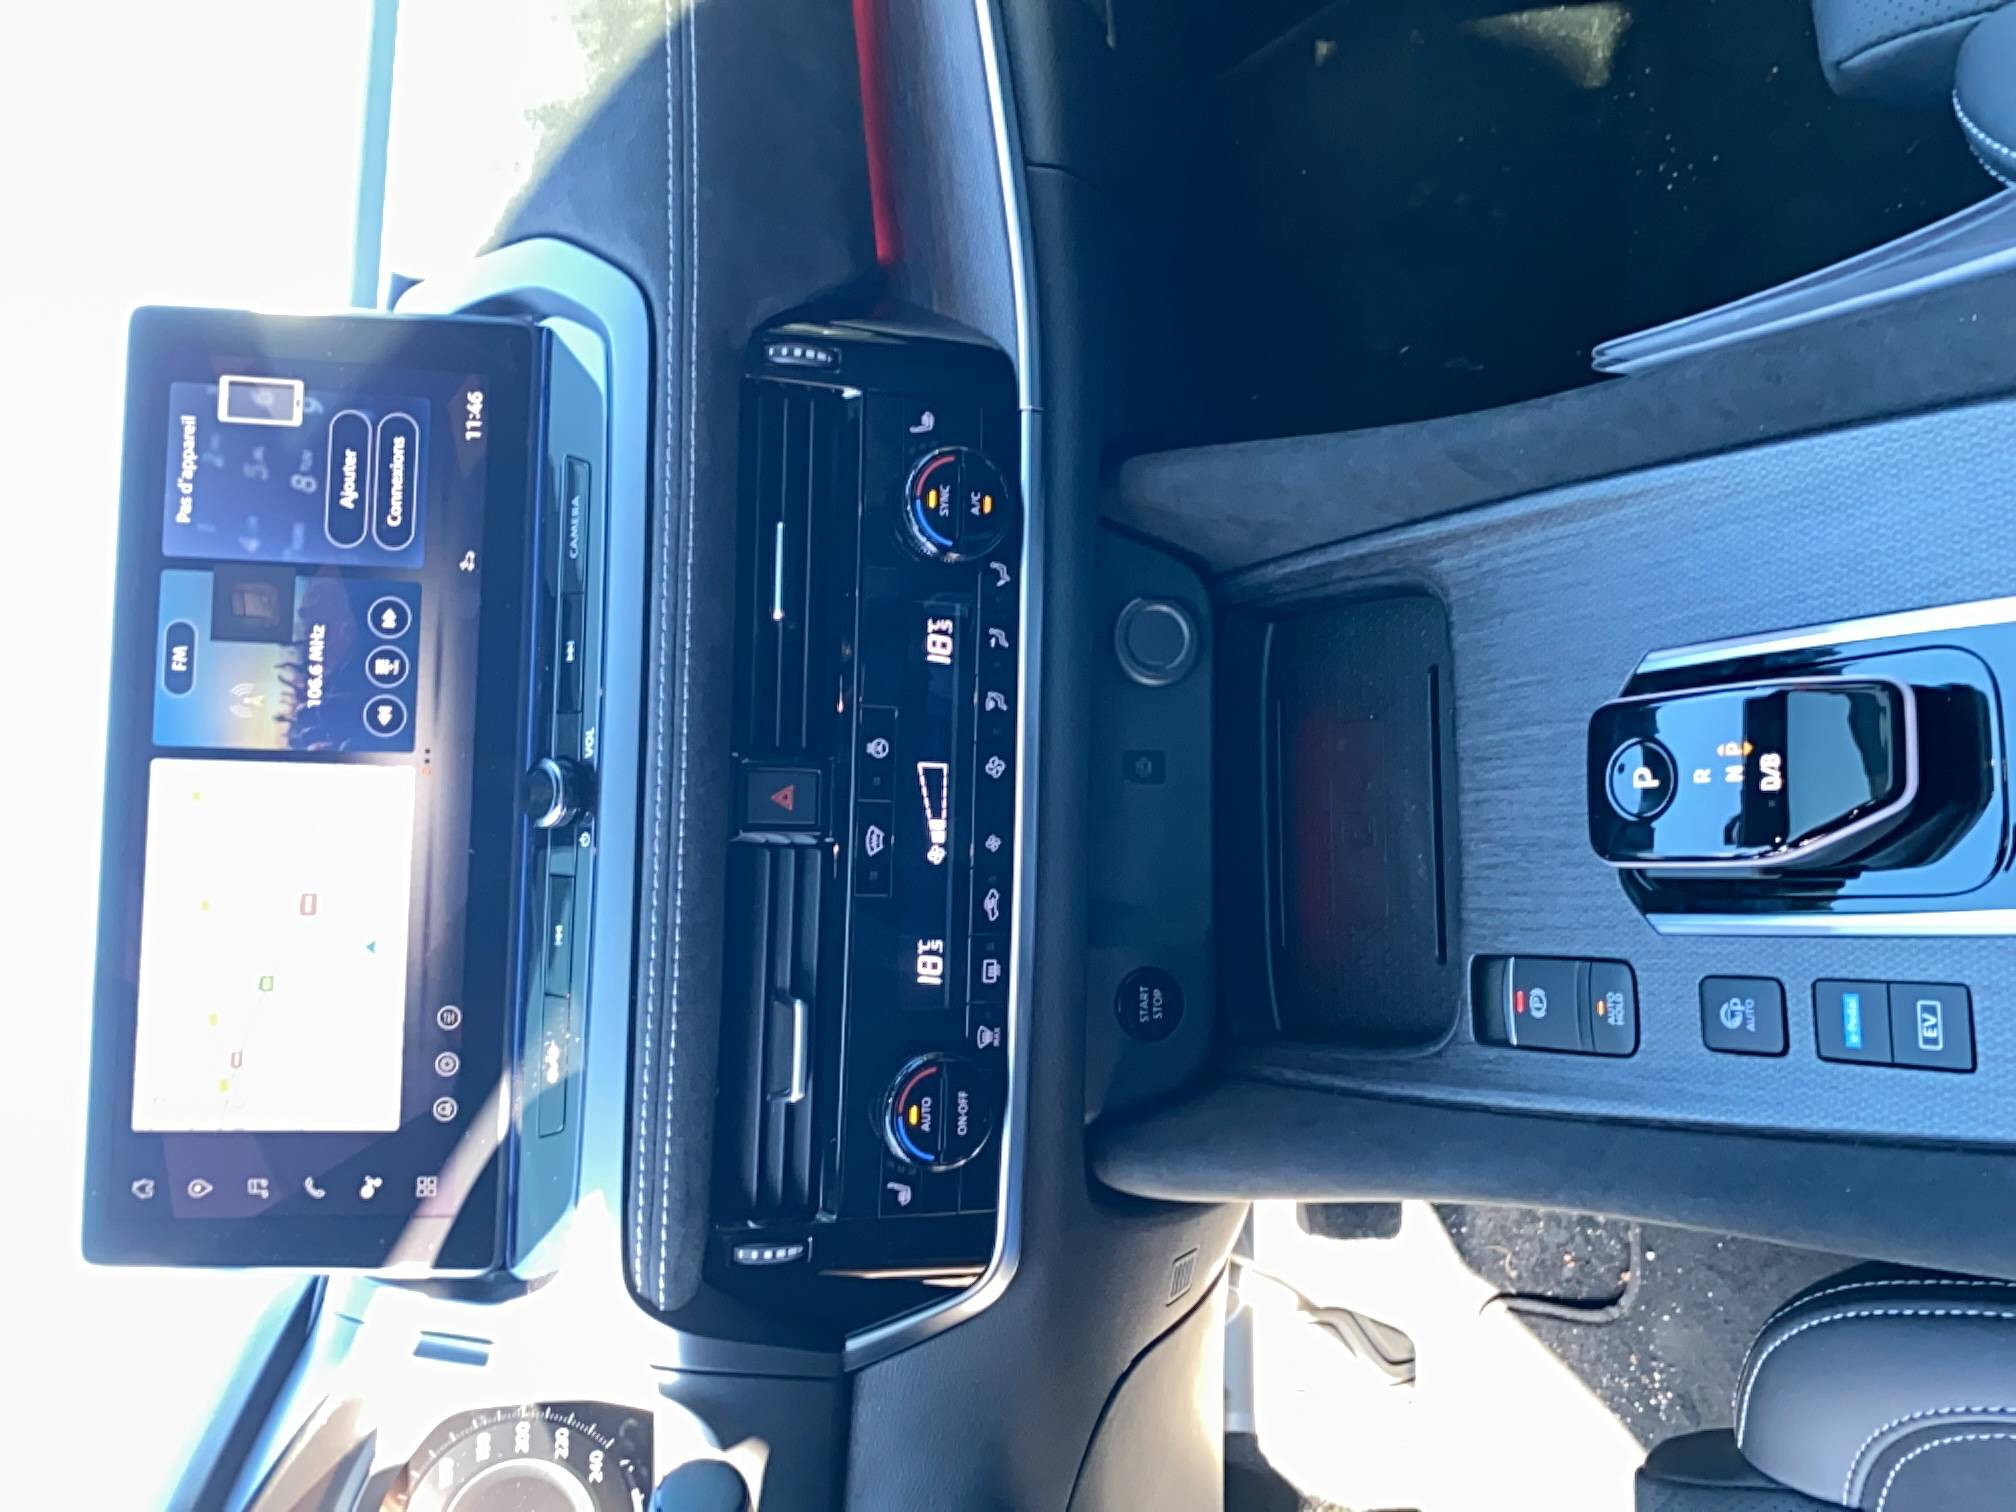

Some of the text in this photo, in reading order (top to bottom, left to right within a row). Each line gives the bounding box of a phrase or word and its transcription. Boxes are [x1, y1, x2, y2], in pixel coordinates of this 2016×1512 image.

[465, 390, 483, 441] 11:46
[176, 415, 198, 523] Pas d'appareil
[338, 448, 359, 509] Ajouter
[386, 436, 406, 527] Connexions
[939, 484, 951, 517] SYNC
[969, 491, 981, 516] A/C
[569, 495, 580, 559] CAMERA
[171, 645, 189, 672] FM
[306, 623, 327, 708] 106.6 MHz
[583, 727, 595, 758] VOL
[1633, 766, 1660, 789] P
[1693, 768, 1711, 784] R
[1725, 765, 1744, 783] N
[1760, 753, 1782, 792] D/B
[1139, 985, 1150, 1023] START
[1152, 988, 1163, 1020] STOP
[1607, 992, 1616, 1025] AUTO
[1615, 993, 1624, 1026] HOLD
[1746, 998, 1756, 1032] AUTO
[1922, 1014, 1938, 1038] EV
[920, 1096, 932, 1132] AUTO
[554, 1427, 569, 1459] 220
[589, 1450, 604, 1483] 240
